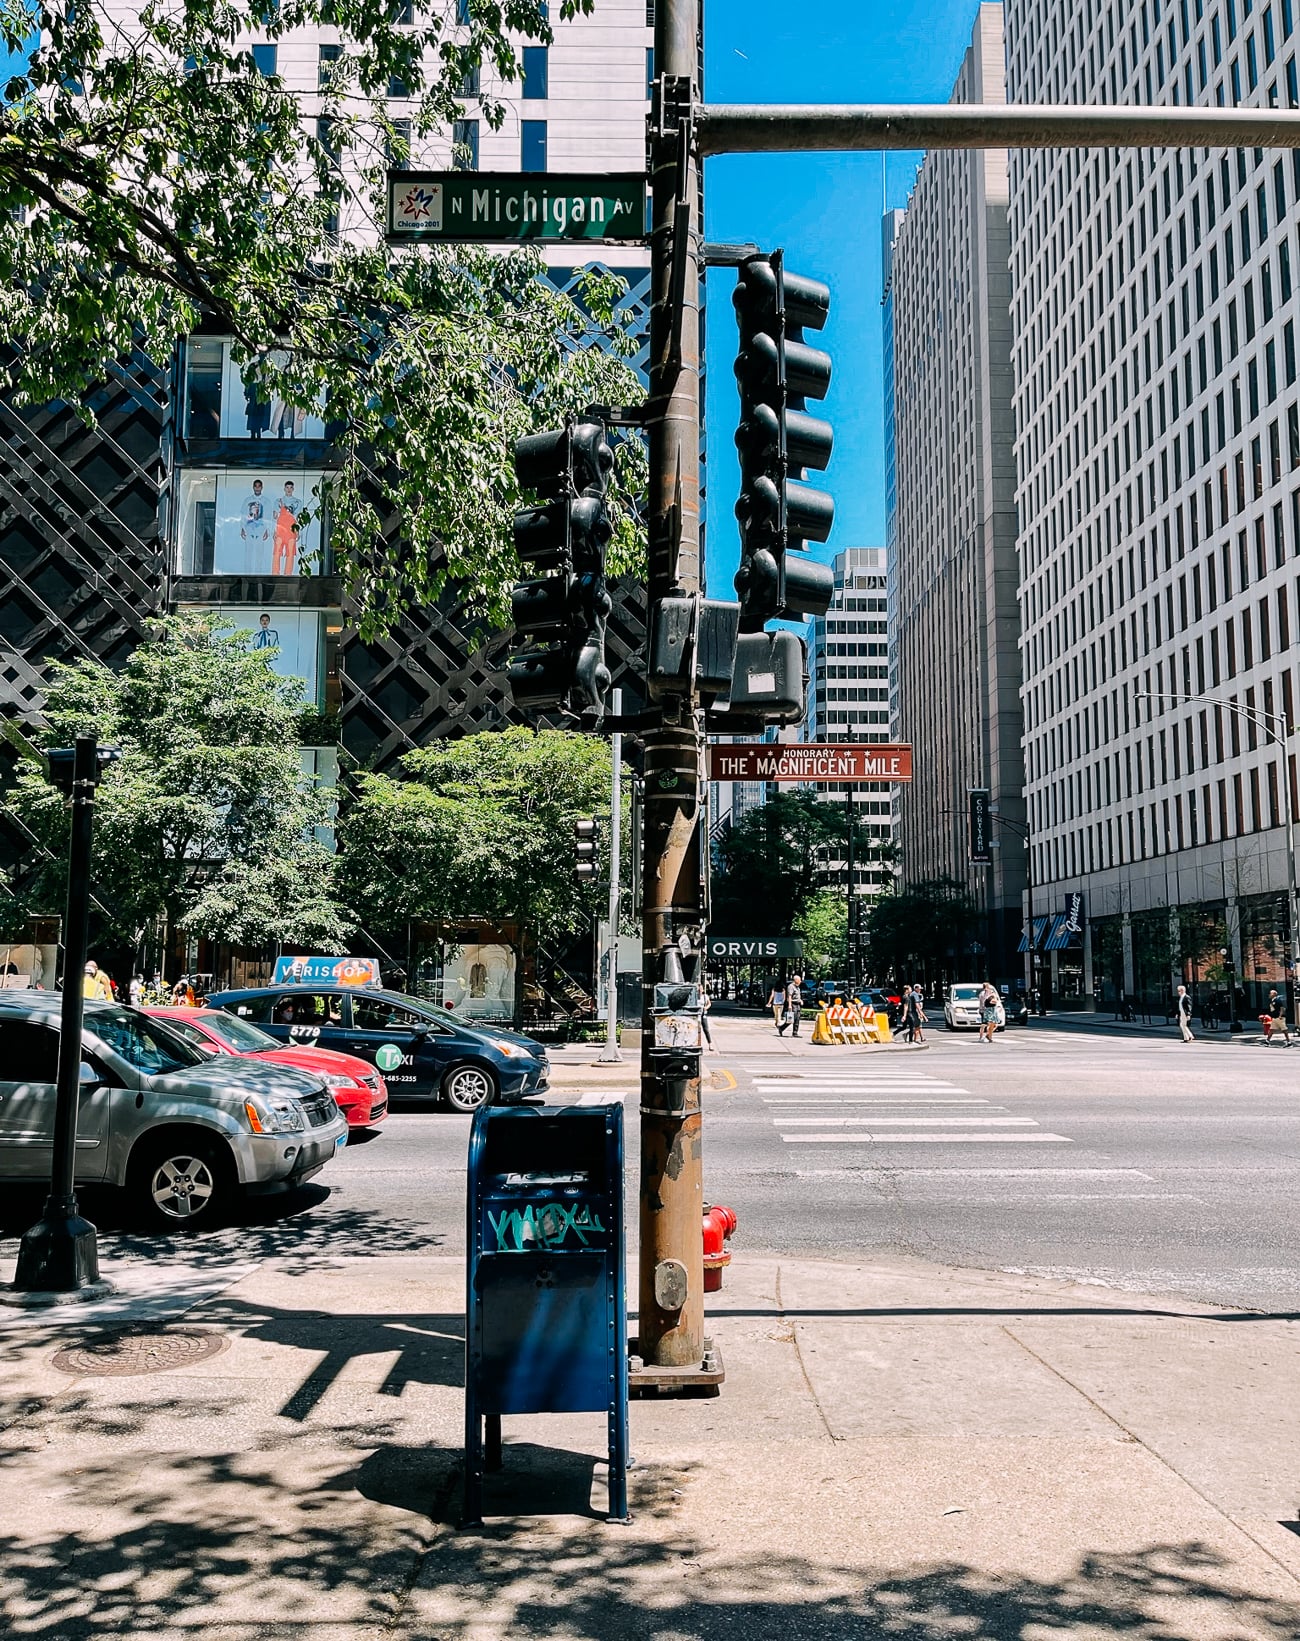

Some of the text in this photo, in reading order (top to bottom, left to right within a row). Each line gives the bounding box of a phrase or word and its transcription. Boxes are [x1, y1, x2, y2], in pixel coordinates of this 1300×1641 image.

[452, 197, 463, 214] N
[472, 188, 605, 234] Michigan
[783, 748, 836, 758] HONORARY
[719, 757, 900, 775] THE MAGNIFICENT MILE
[712, 942, 778, 956] ORVIS
[282, 965, 366, 978] VERISHOP
[290, 1025, 321, 1037] 5779
[382, 1048, 414, 1068] TAXI
